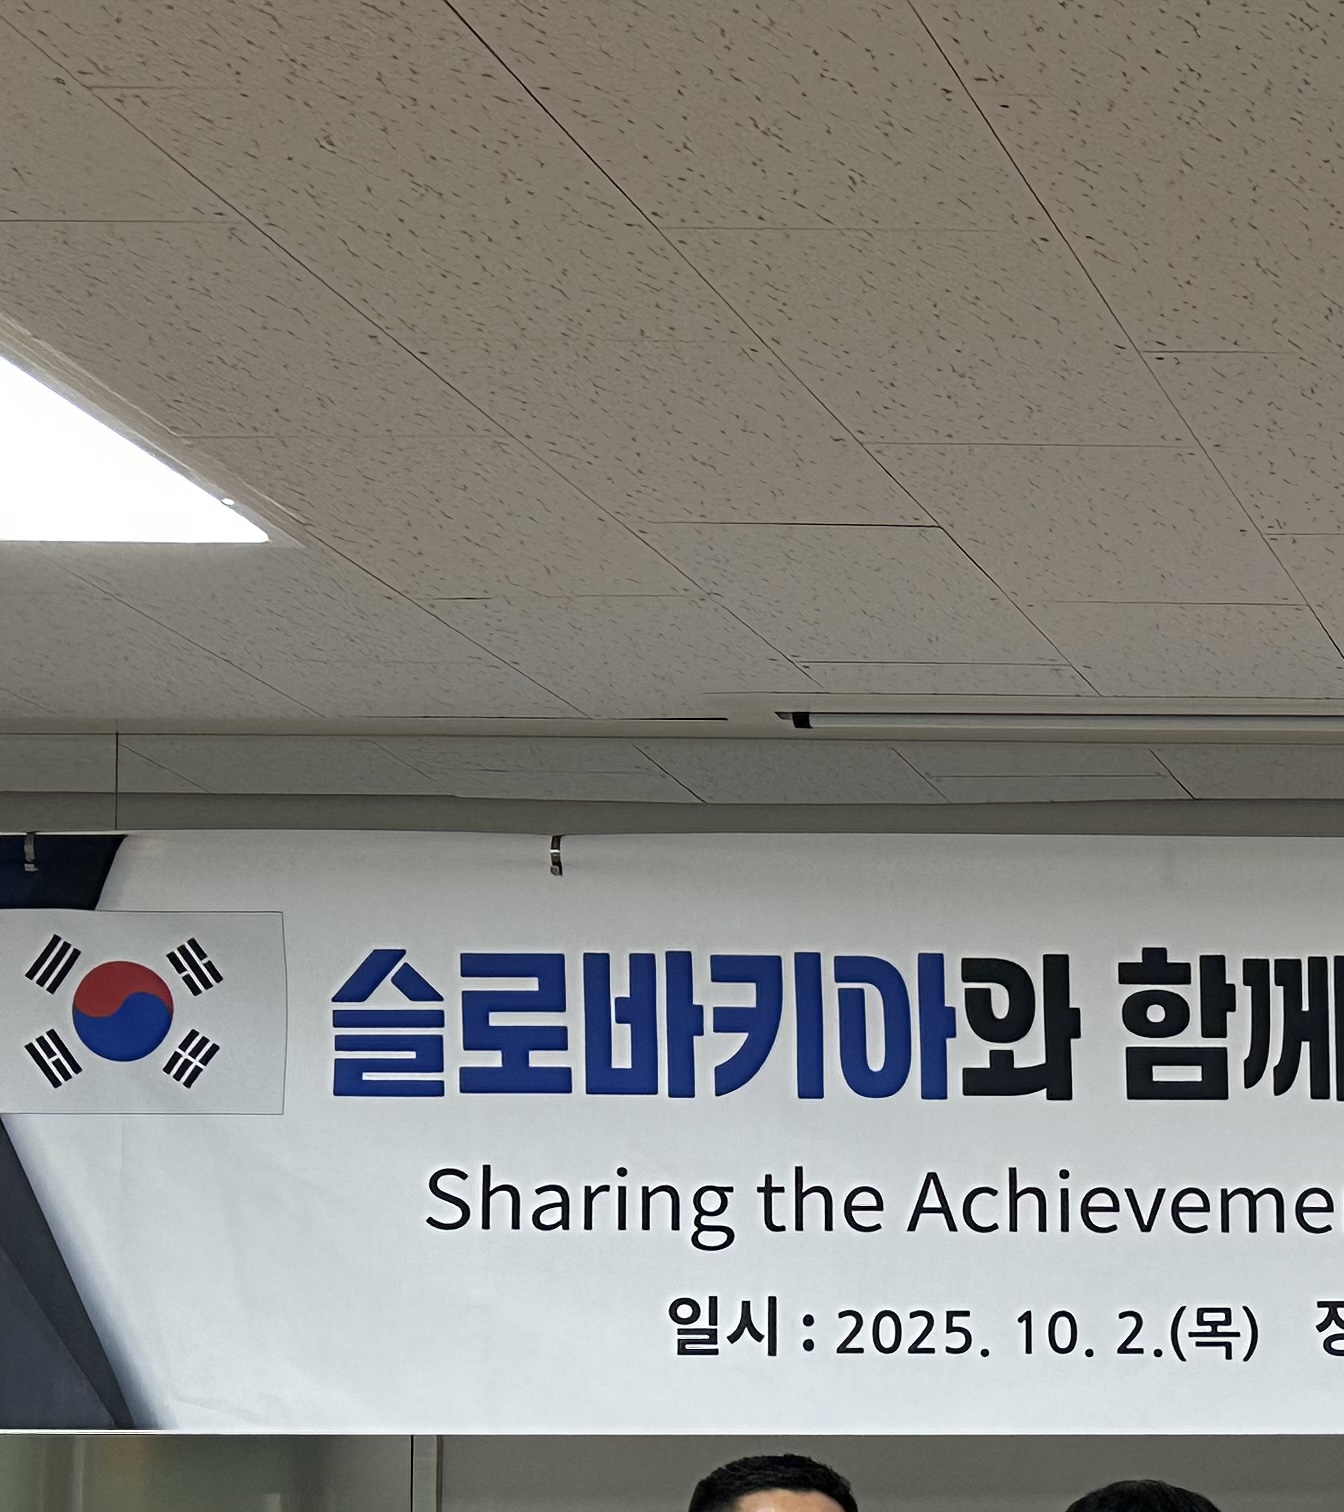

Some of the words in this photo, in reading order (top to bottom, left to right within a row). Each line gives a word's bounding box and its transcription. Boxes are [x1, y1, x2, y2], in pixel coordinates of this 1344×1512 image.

[331, 948, 1082, 1102] 슬로바키아와
[425, 1163, 736, 1252] Sharing
[756, 1165, 885, 1233] the
[835, 1309, 990, 1358] 2025.
[1016, 1309, 1095, 1359] 10.
[1116, 1305, 1259, 1363] 2.(목)
